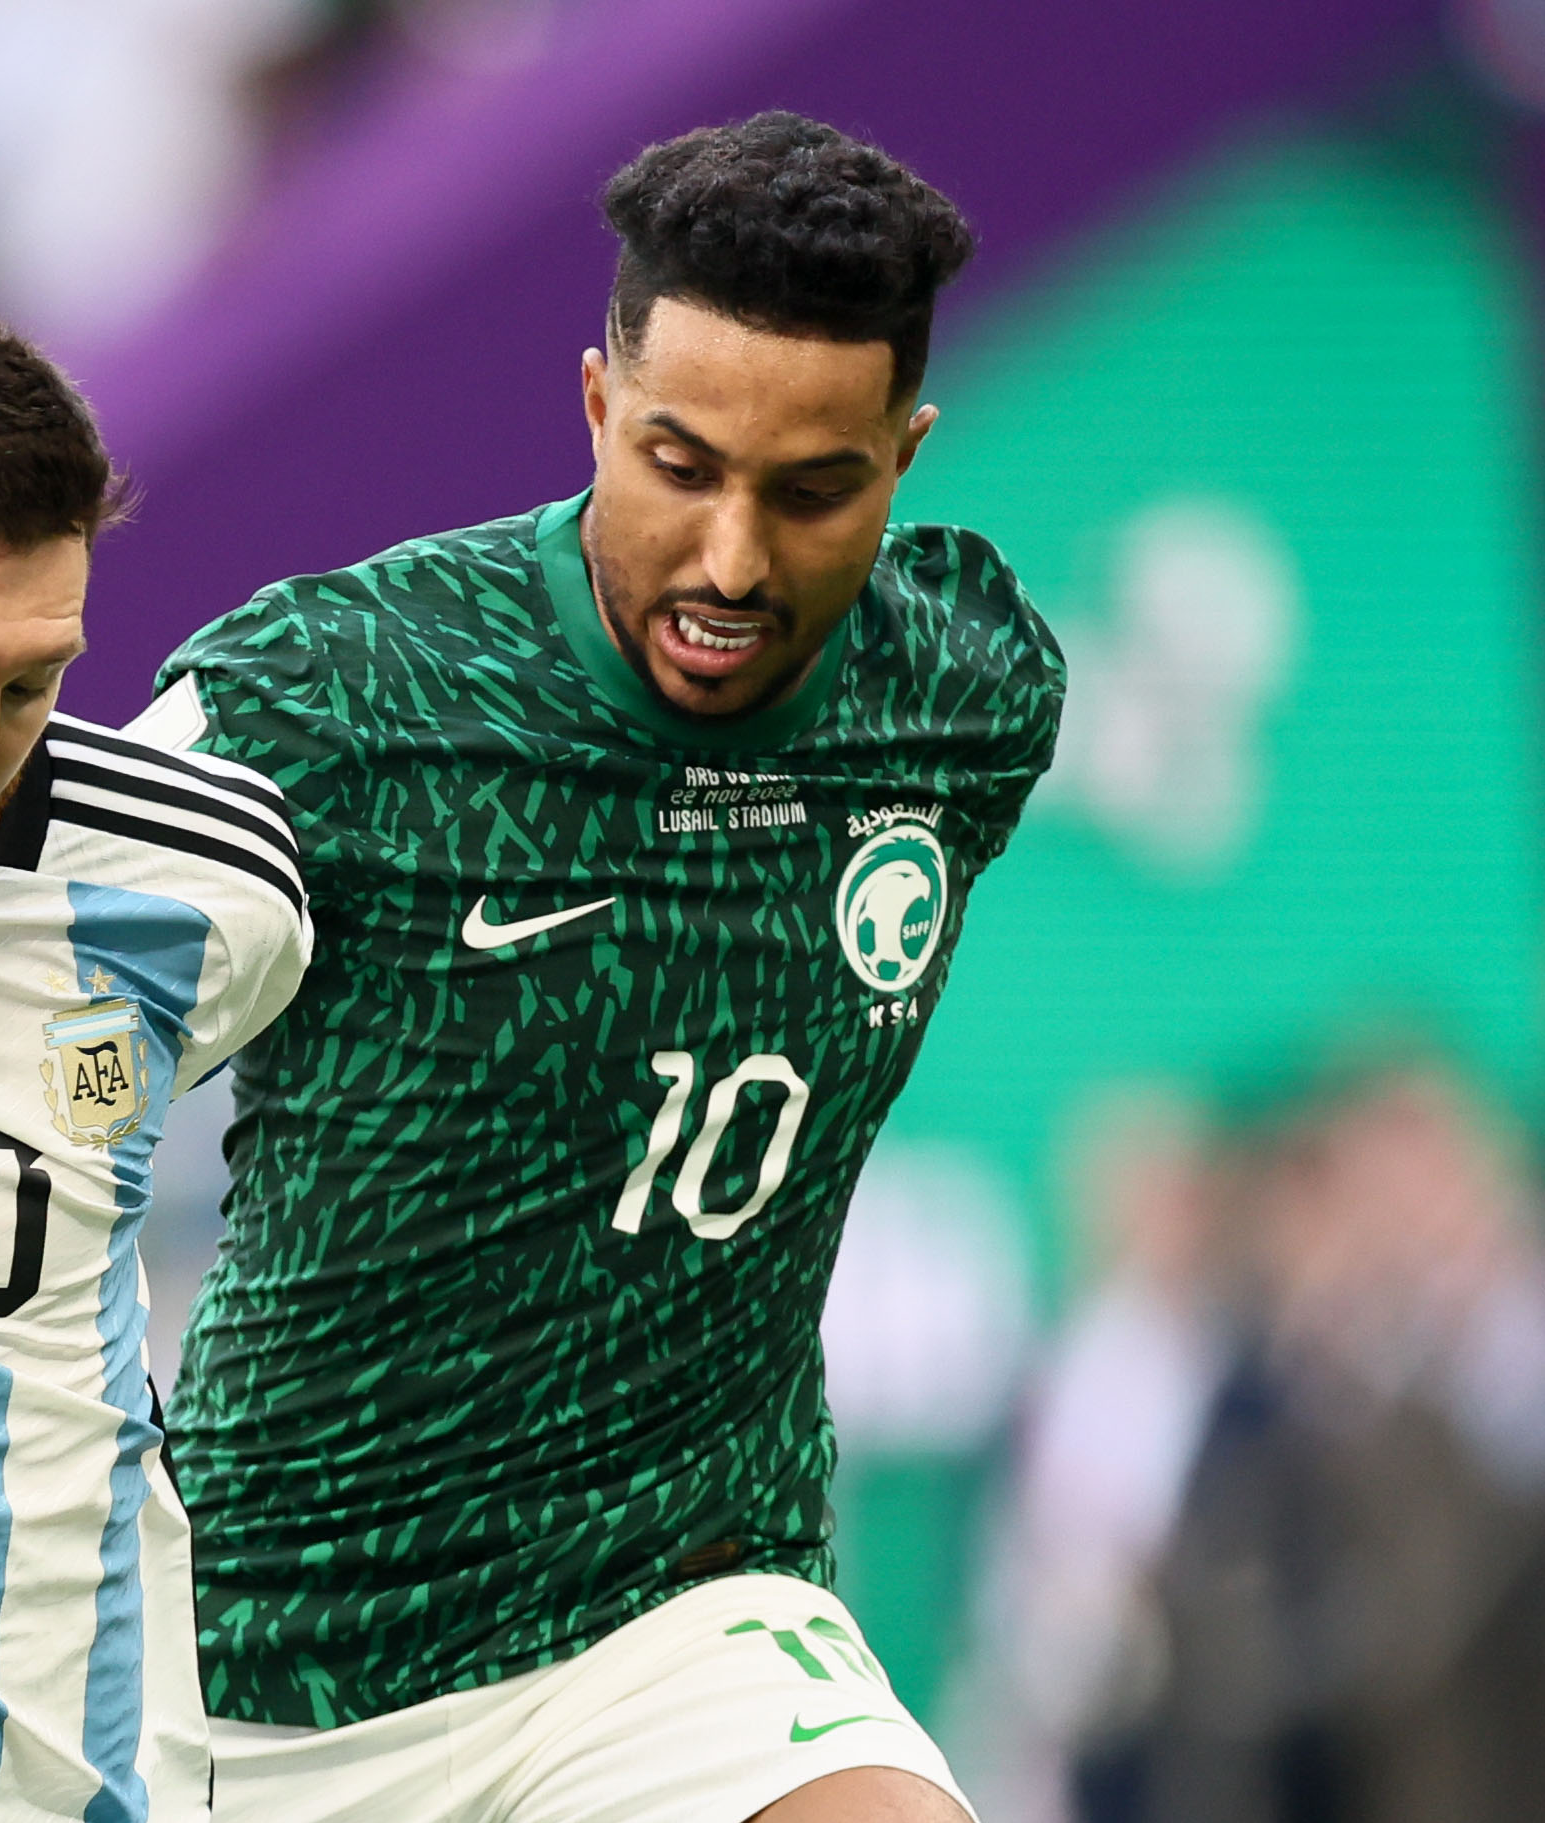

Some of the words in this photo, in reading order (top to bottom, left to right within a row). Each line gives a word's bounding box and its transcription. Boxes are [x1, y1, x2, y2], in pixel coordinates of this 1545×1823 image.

[671, 789, 697, 805] 22
[747, 784, 798, 801] 2022
[659, 809, 719, 833] LUSAIL
[728, 801, 807, 829] STADIUM
[847, 802, 944, 838] السعودية
[902, 920, 930, 940] SAFF
[869, 997, 918, 1028] KSA
[73, 1041, 129, 1106] AFA
[611, 1050, 810, 1241] 10
